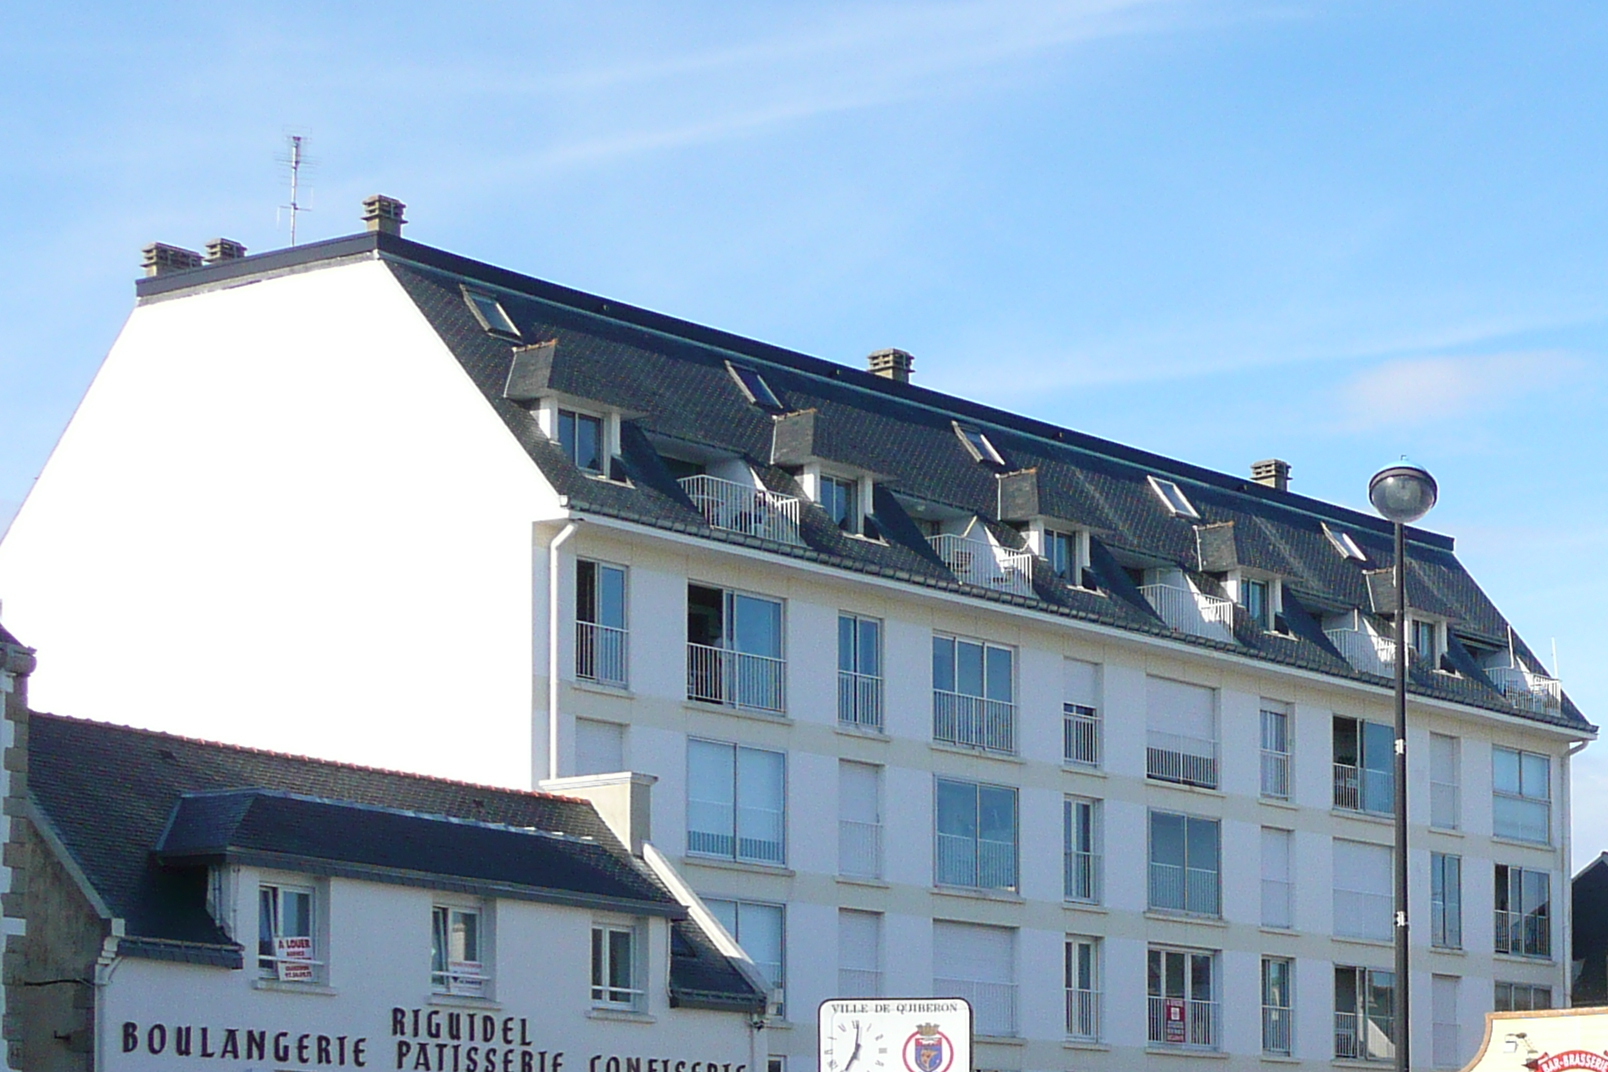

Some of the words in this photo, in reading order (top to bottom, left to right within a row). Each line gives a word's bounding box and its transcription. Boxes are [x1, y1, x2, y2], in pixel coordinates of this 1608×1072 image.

[391, 1006, 532, 1047] RIGUIDEL
[831, 1003, 869, 1014] VILLE
[874, 1003, 891, 1013] DE
[896, 1002, 958, 1015] QUIBERON
[121, 1021, 367, 1068] BOULANGERIE
